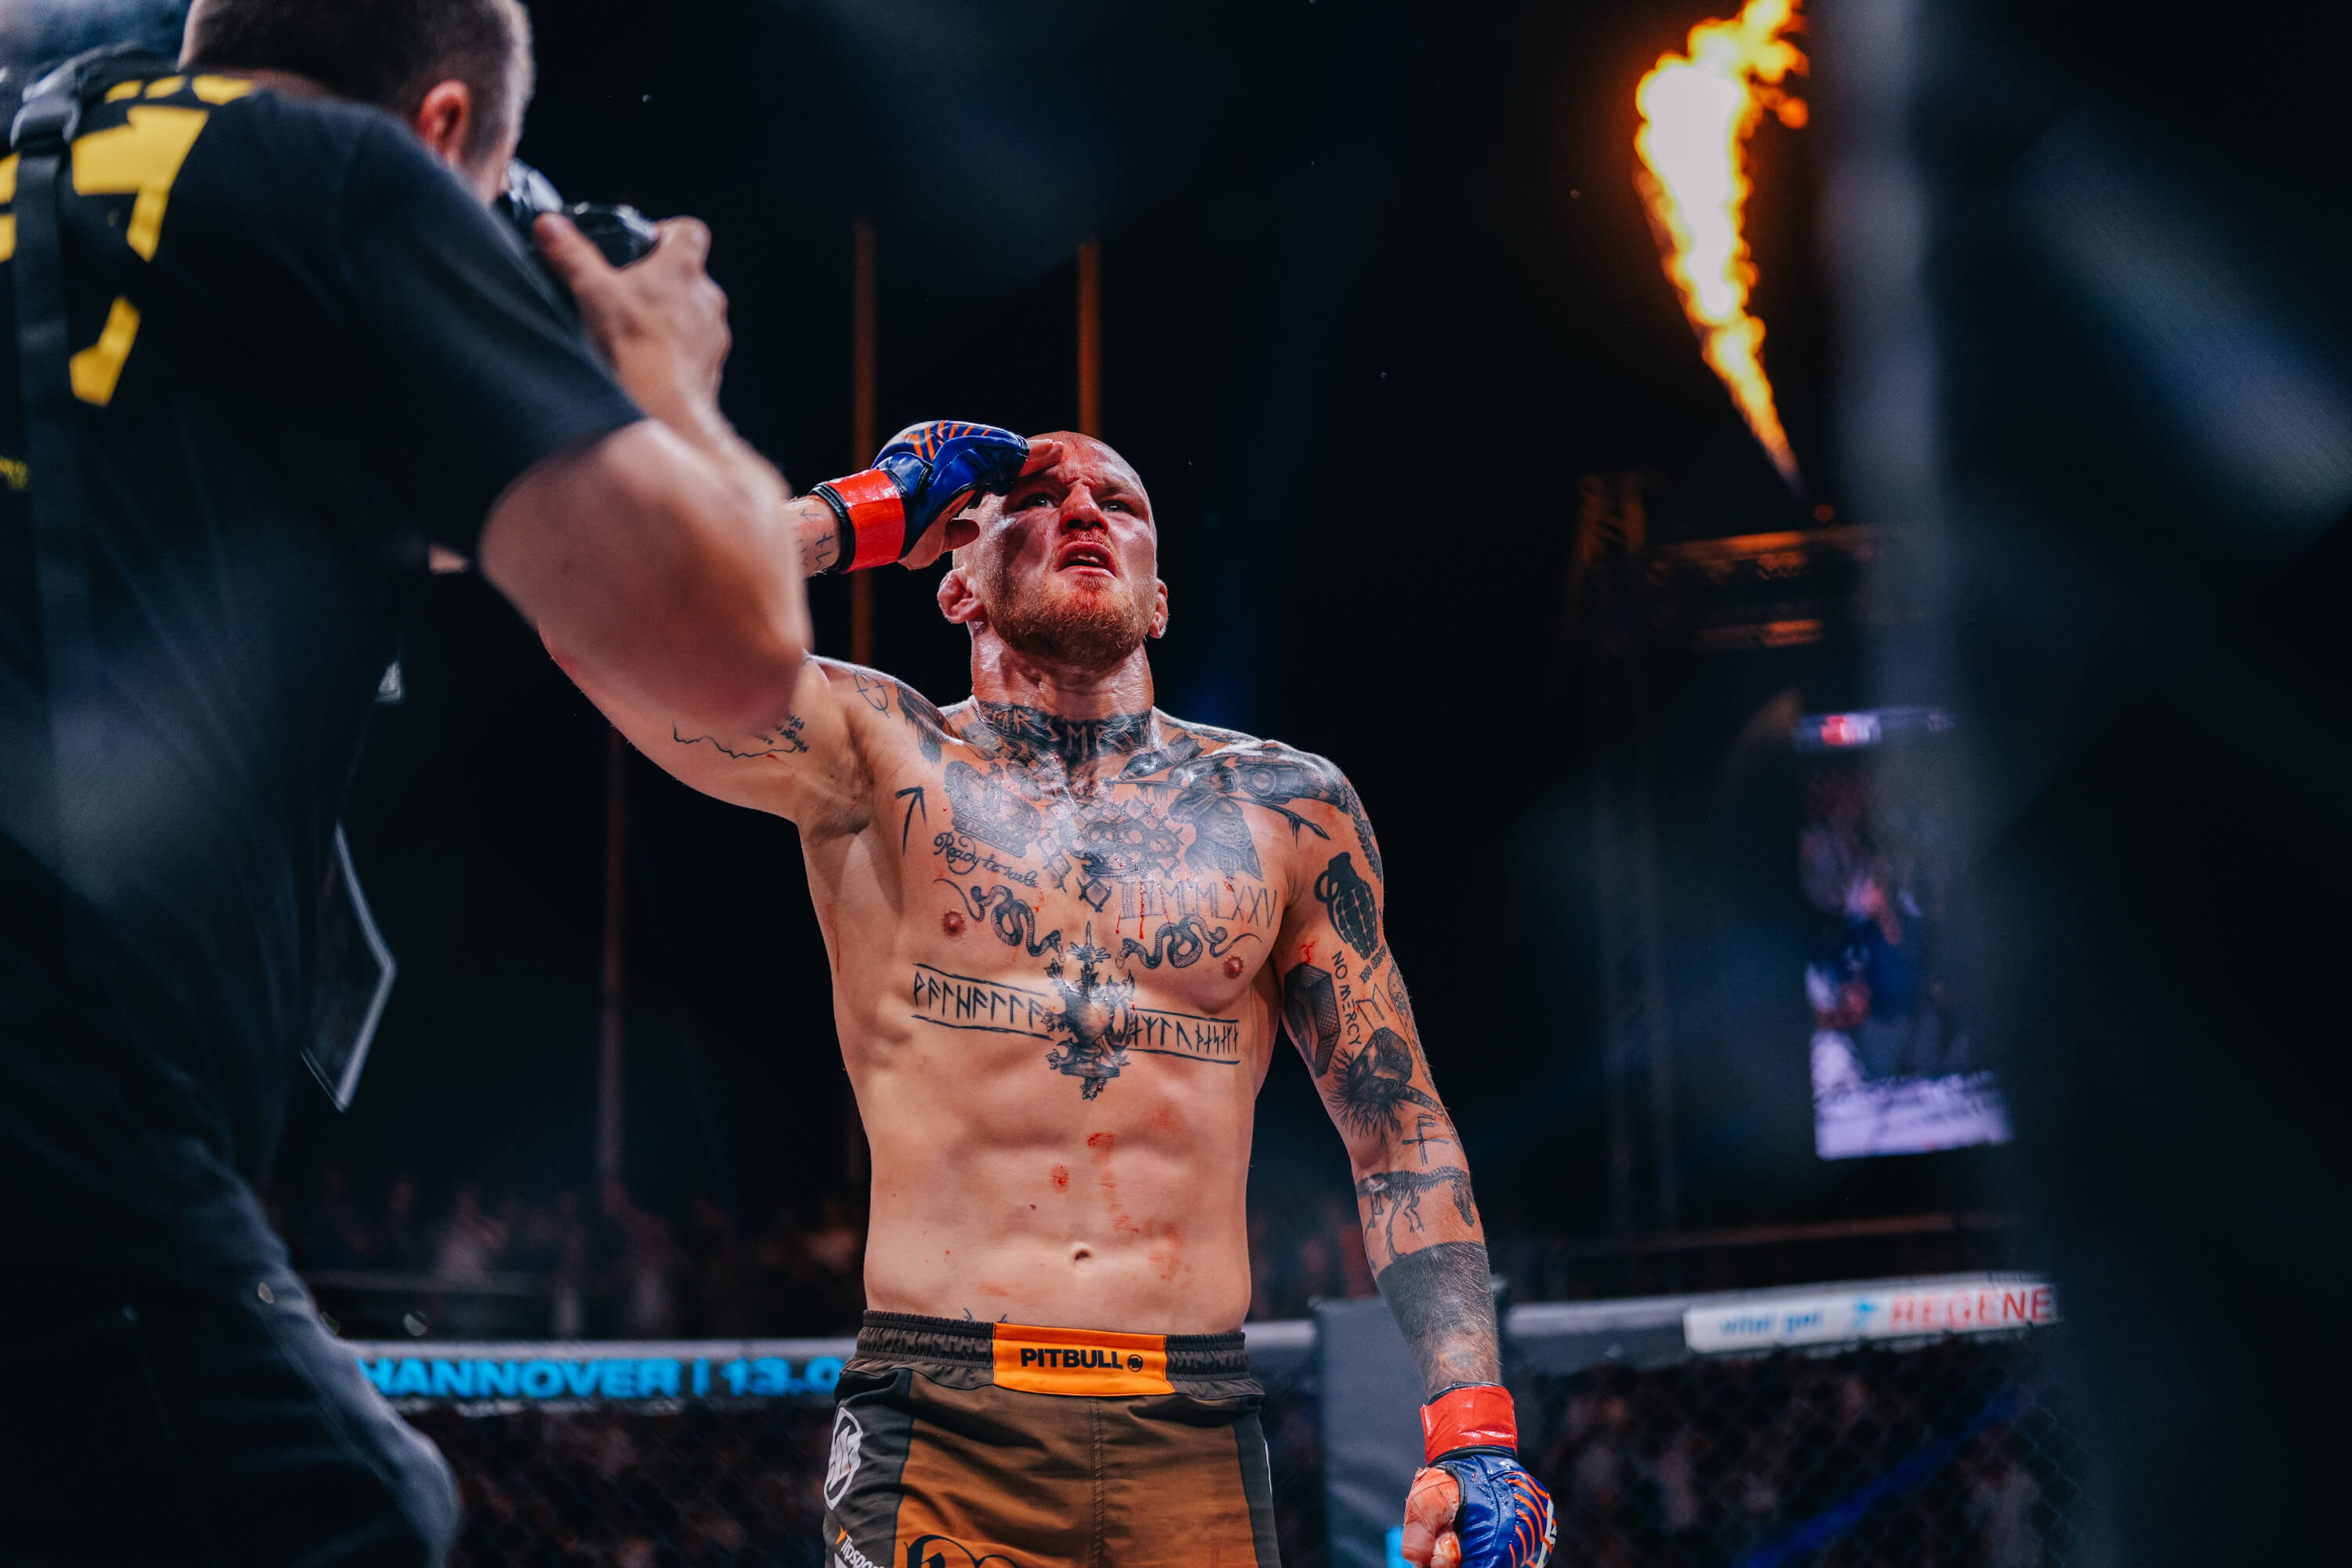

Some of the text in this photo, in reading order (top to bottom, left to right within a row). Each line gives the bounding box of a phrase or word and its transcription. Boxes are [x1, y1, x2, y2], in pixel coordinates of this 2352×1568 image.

[933, 831, 981, 875] Ready
[982, 853, 1013, 873] to
[1331, 950, 1363, 1045] NO MERCY
[356, 1357, 683, 1398] HANNOVER
[1020, 1348, 1123, 1370] PITBULL
